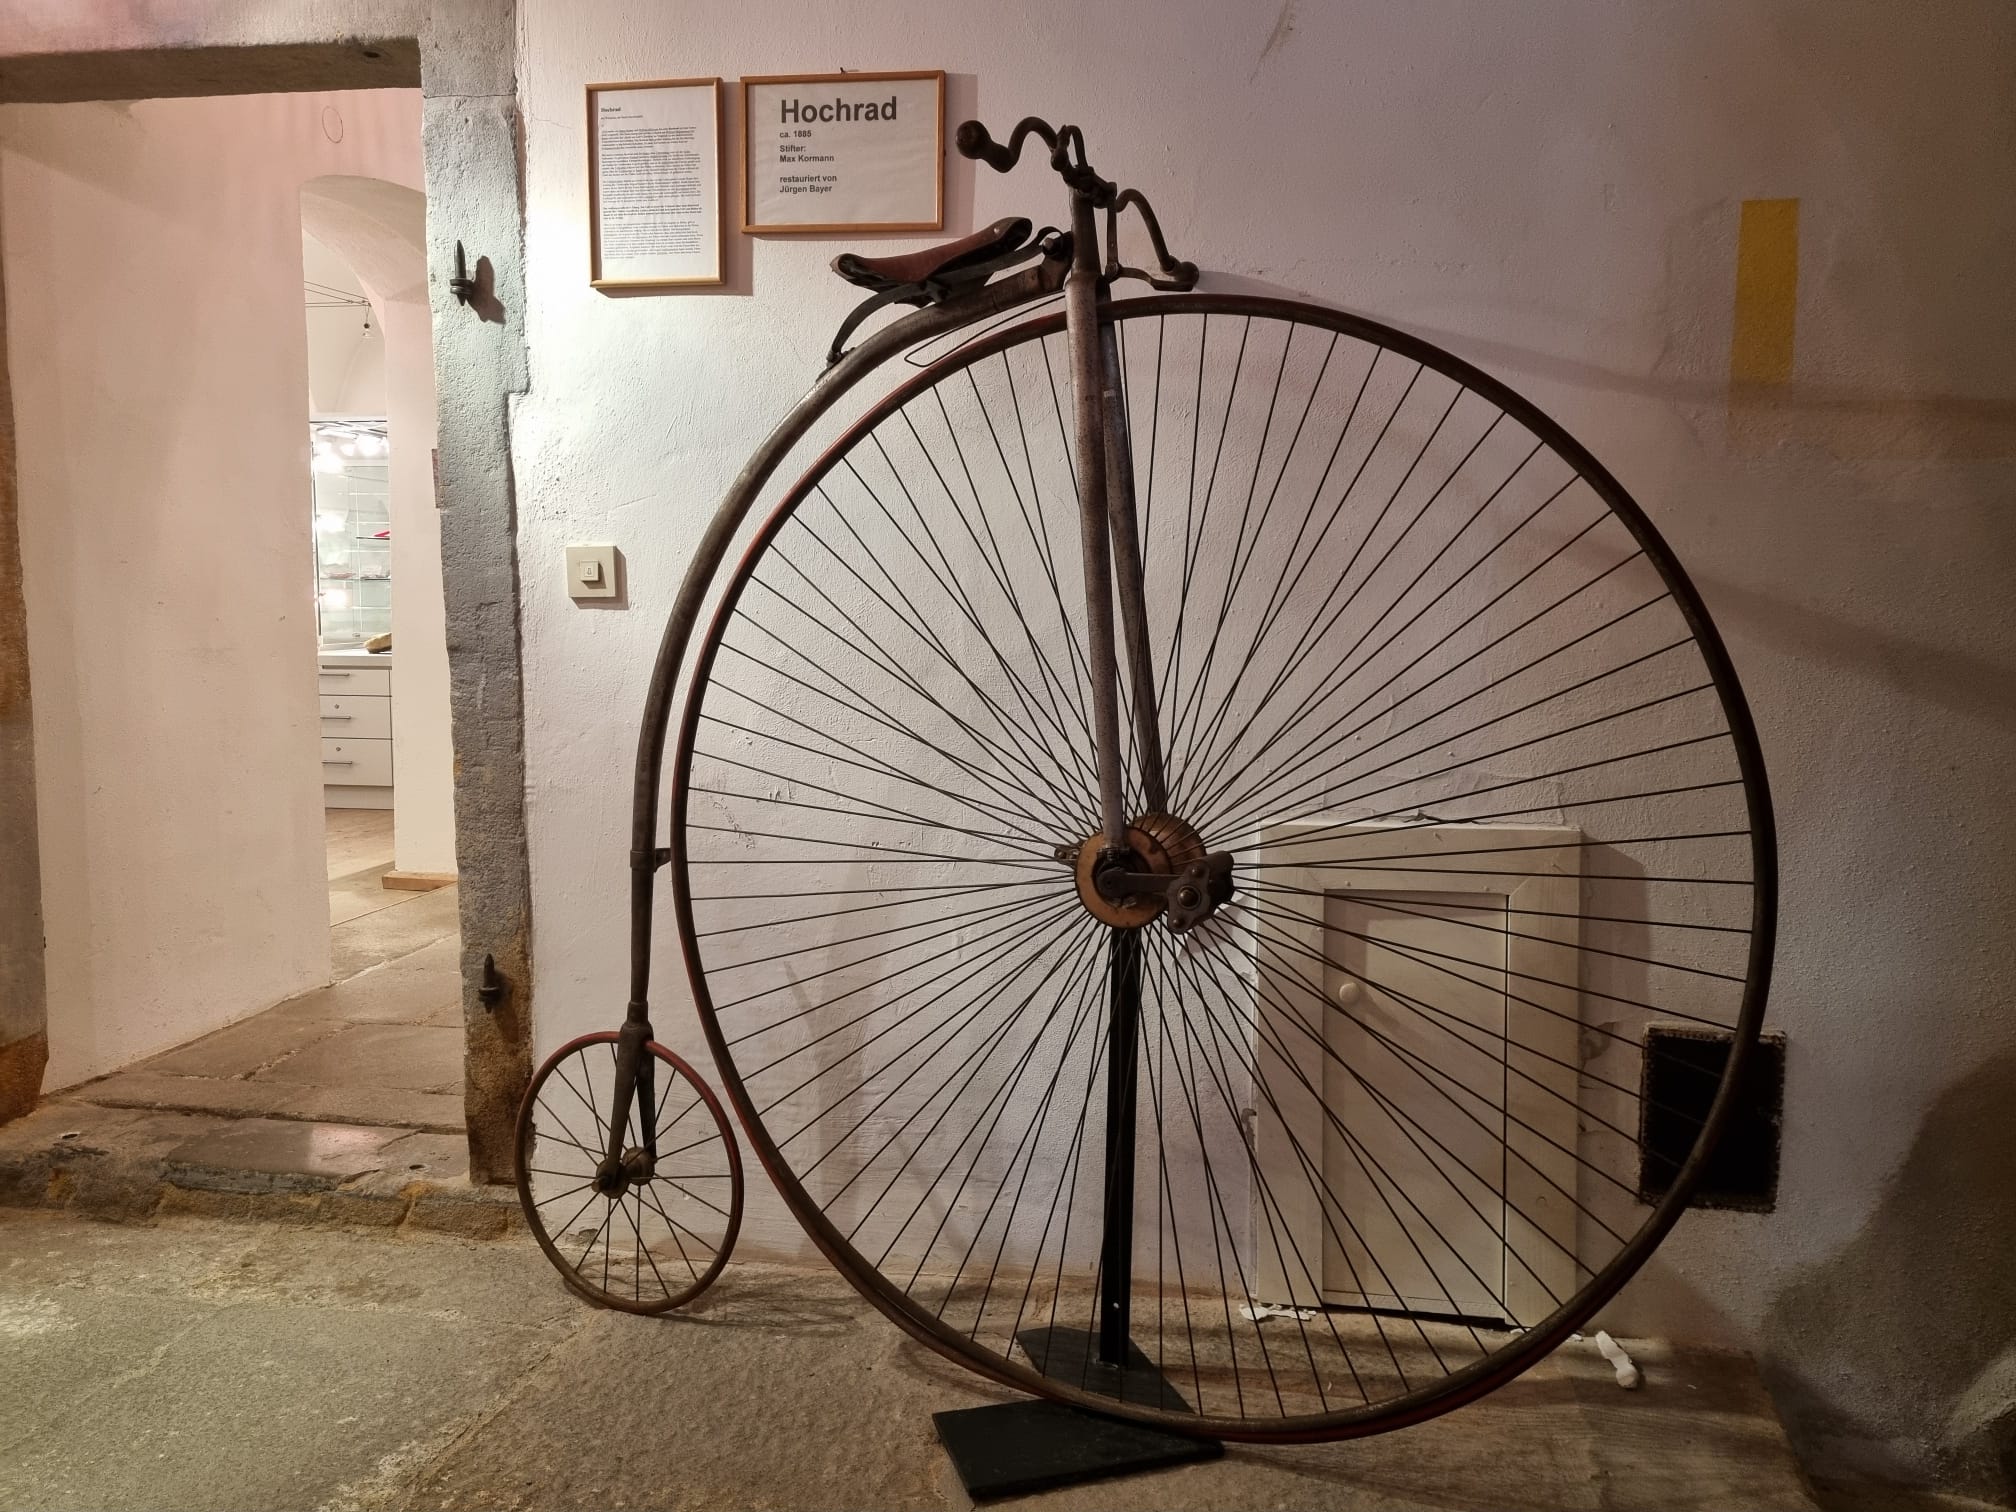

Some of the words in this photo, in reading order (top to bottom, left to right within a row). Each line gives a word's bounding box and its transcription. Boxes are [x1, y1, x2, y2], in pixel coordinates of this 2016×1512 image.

[781, 96, 897, 124] Hochrad
[793, 130, 812, 138] 1885
[779, 145, 806, 153] Stifter:
[779, 155, 796, 163] Max
[798, 154, 835, 162] Kormann
[779, 174, 821, 183] restauriert
[779, 184, 808, 195] Jürgen
[809, 184, 833, 194] Bayer
